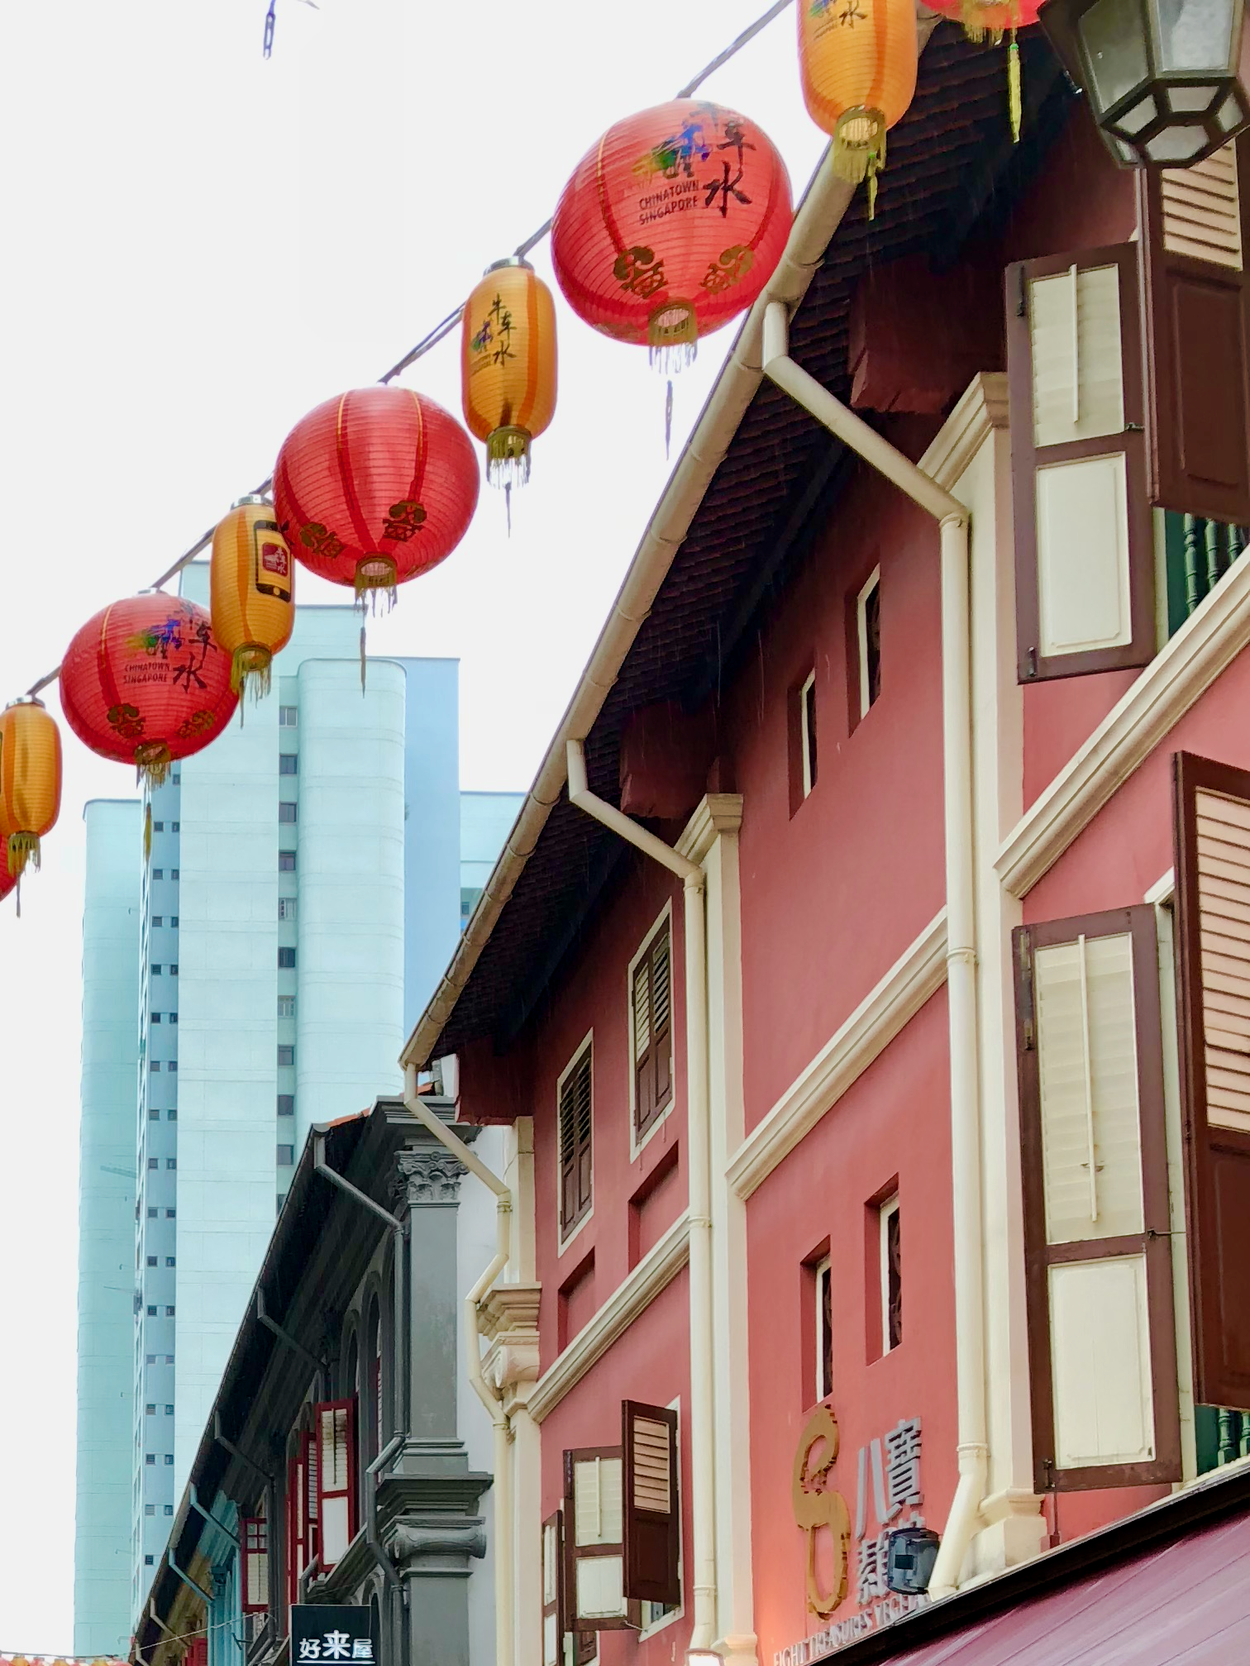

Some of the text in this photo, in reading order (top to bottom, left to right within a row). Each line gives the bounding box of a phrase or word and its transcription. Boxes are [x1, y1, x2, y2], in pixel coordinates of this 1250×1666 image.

[639, 180, 700, 210] CHINATOWN
[639, 196, 699, 225] SINGAPORE
[123, 673, 168, 684] SINGAPORE
[299, 1630, 373, 1659] 好来屋
